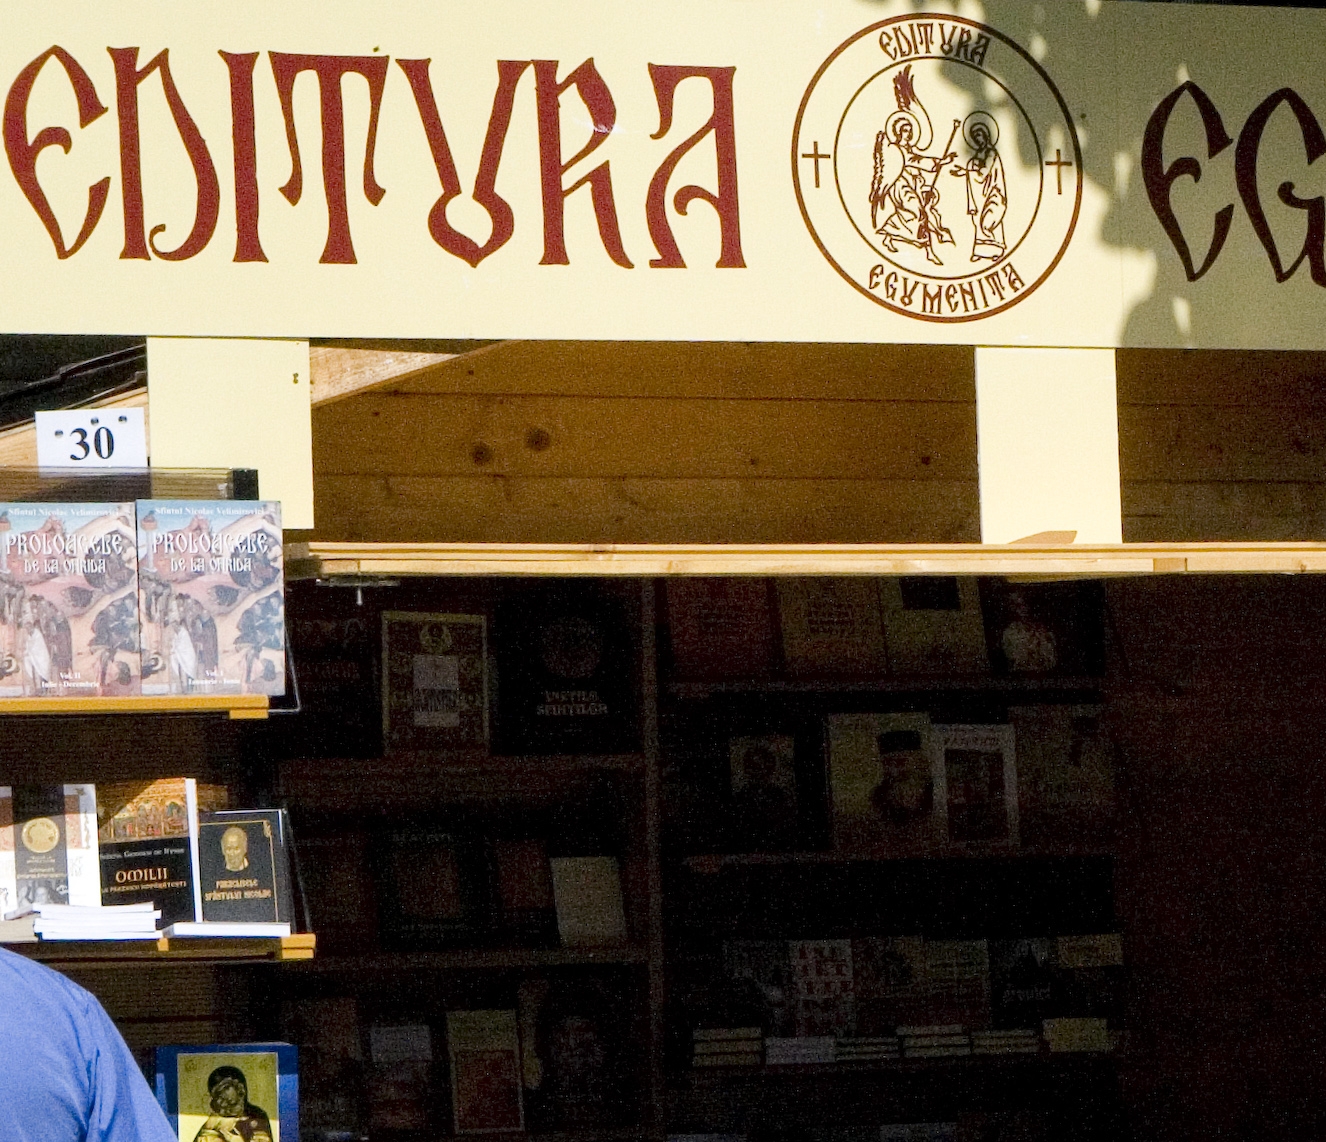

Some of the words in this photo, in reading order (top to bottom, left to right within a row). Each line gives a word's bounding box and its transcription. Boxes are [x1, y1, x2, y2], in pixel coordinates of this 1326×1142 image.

[2, 44, 748, 270] EDITURA
[69, 426, 115, 461] 30
[6, 533, 123, 555] PROLOAGELE
[153, 532, 269, 554] PROLOAGELE
[24, 558, 40, 573] DE
[44, 558, 59, 573] LA
[63, 558, 106, 573] OHRIDA
[170, 557, 187, 572] DE
[190, 557, 205, 572] LA
[209, 557, 252, 573] OHRIDA
[115, 867, 168, 884] OMILII
